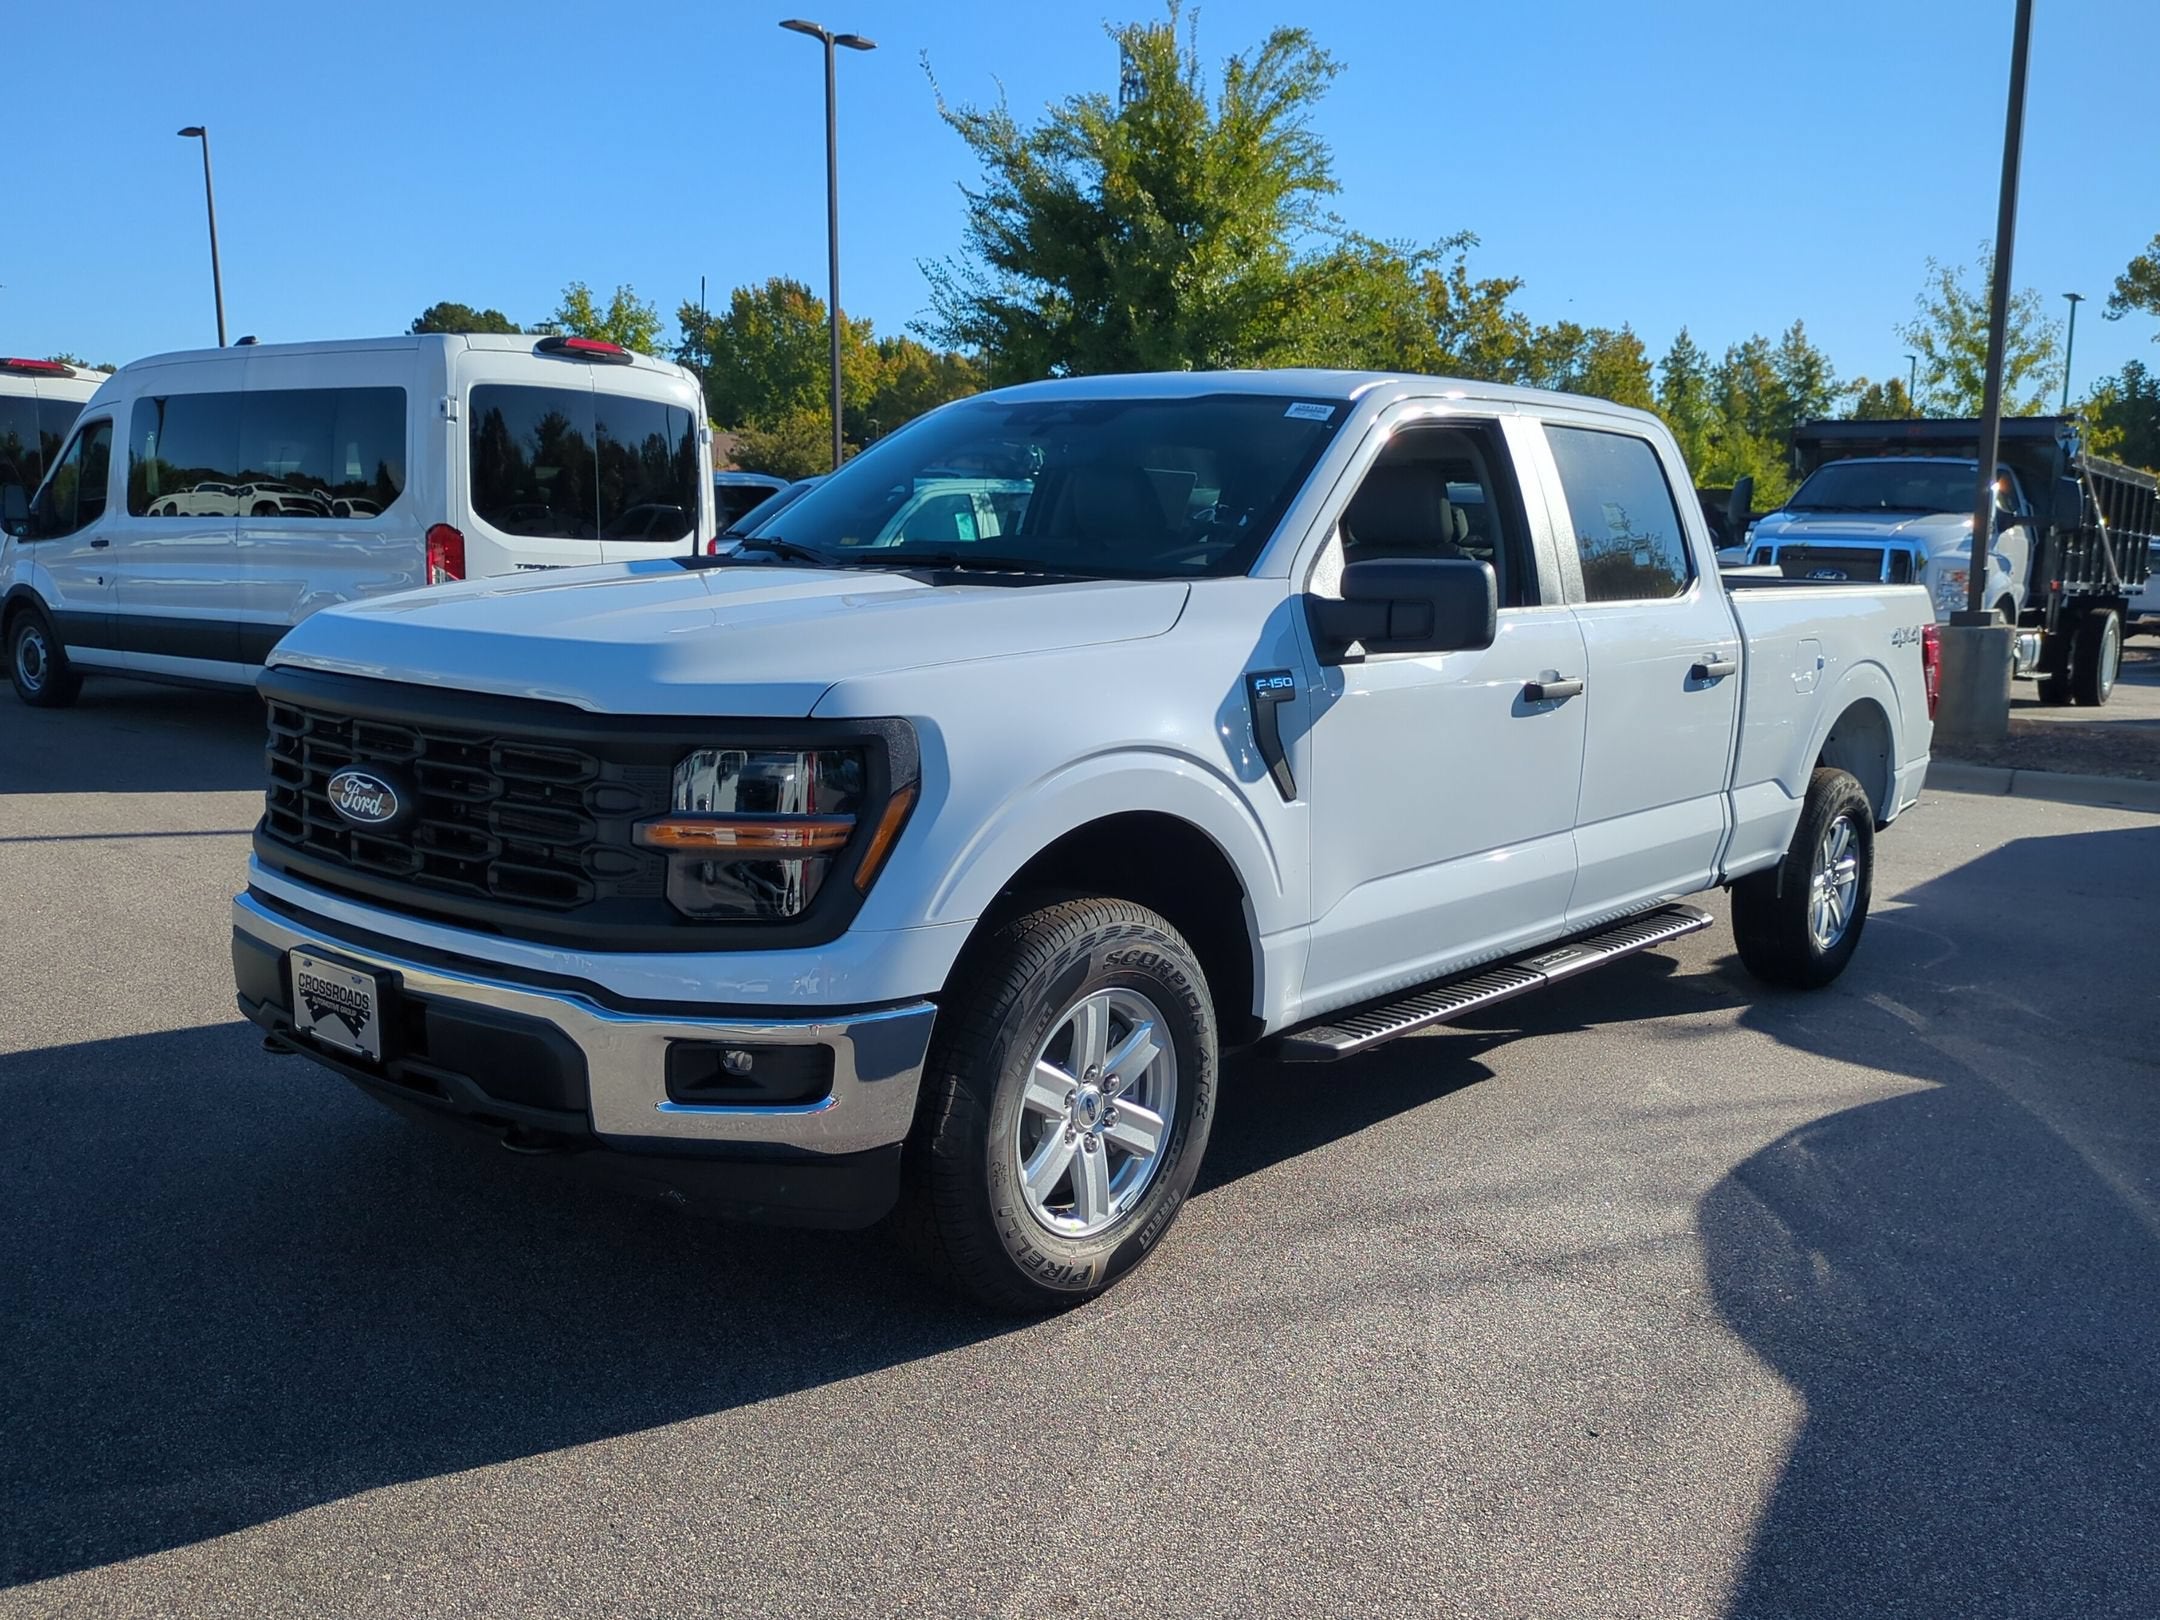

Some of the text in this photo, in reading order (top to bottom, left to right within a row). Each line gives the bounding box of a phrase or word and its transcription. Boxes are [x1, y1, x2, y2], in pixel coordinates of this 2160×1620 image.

[1255, 677, 1293, 690] F-150
[340, 775, 384, 816] Ford
[298, 973, 371, 1010] CROSSROADS
[1103, 949, 1212, 1120] SCORPION ATR
[997, 1203, 1094, 1286] PIRELLI
